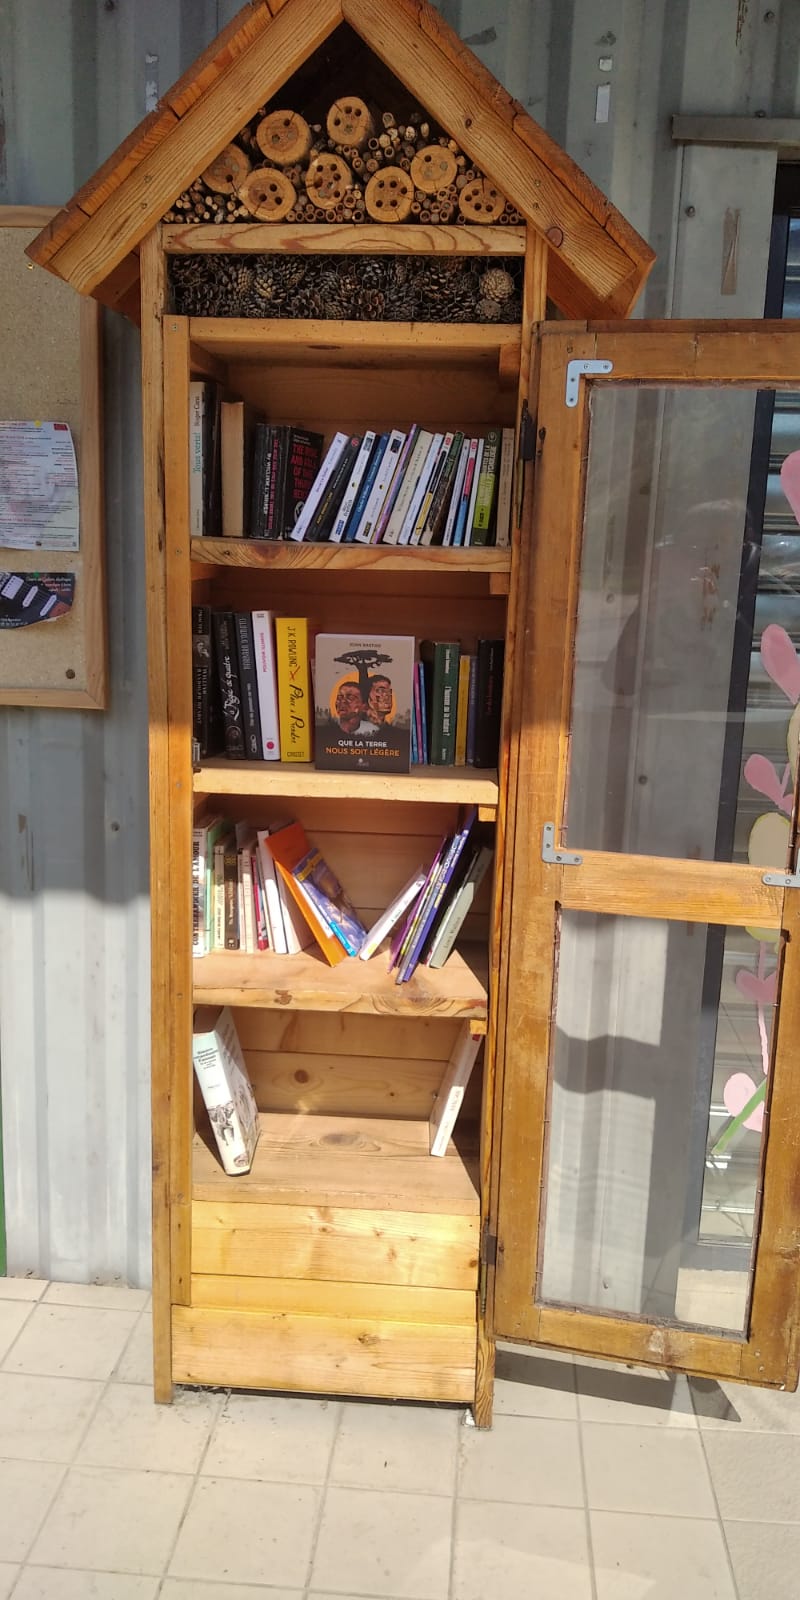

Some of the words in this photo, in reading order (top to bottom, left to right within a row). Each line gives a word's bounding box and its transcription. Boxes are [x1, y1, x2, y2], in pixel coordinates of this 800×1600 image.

[288, 638, 297, 668] ROWLING
[222, 656, 238, 680] quatre
[326, 747, 348, 755] NOUS
[350, 748, 368, 756] SOIT
